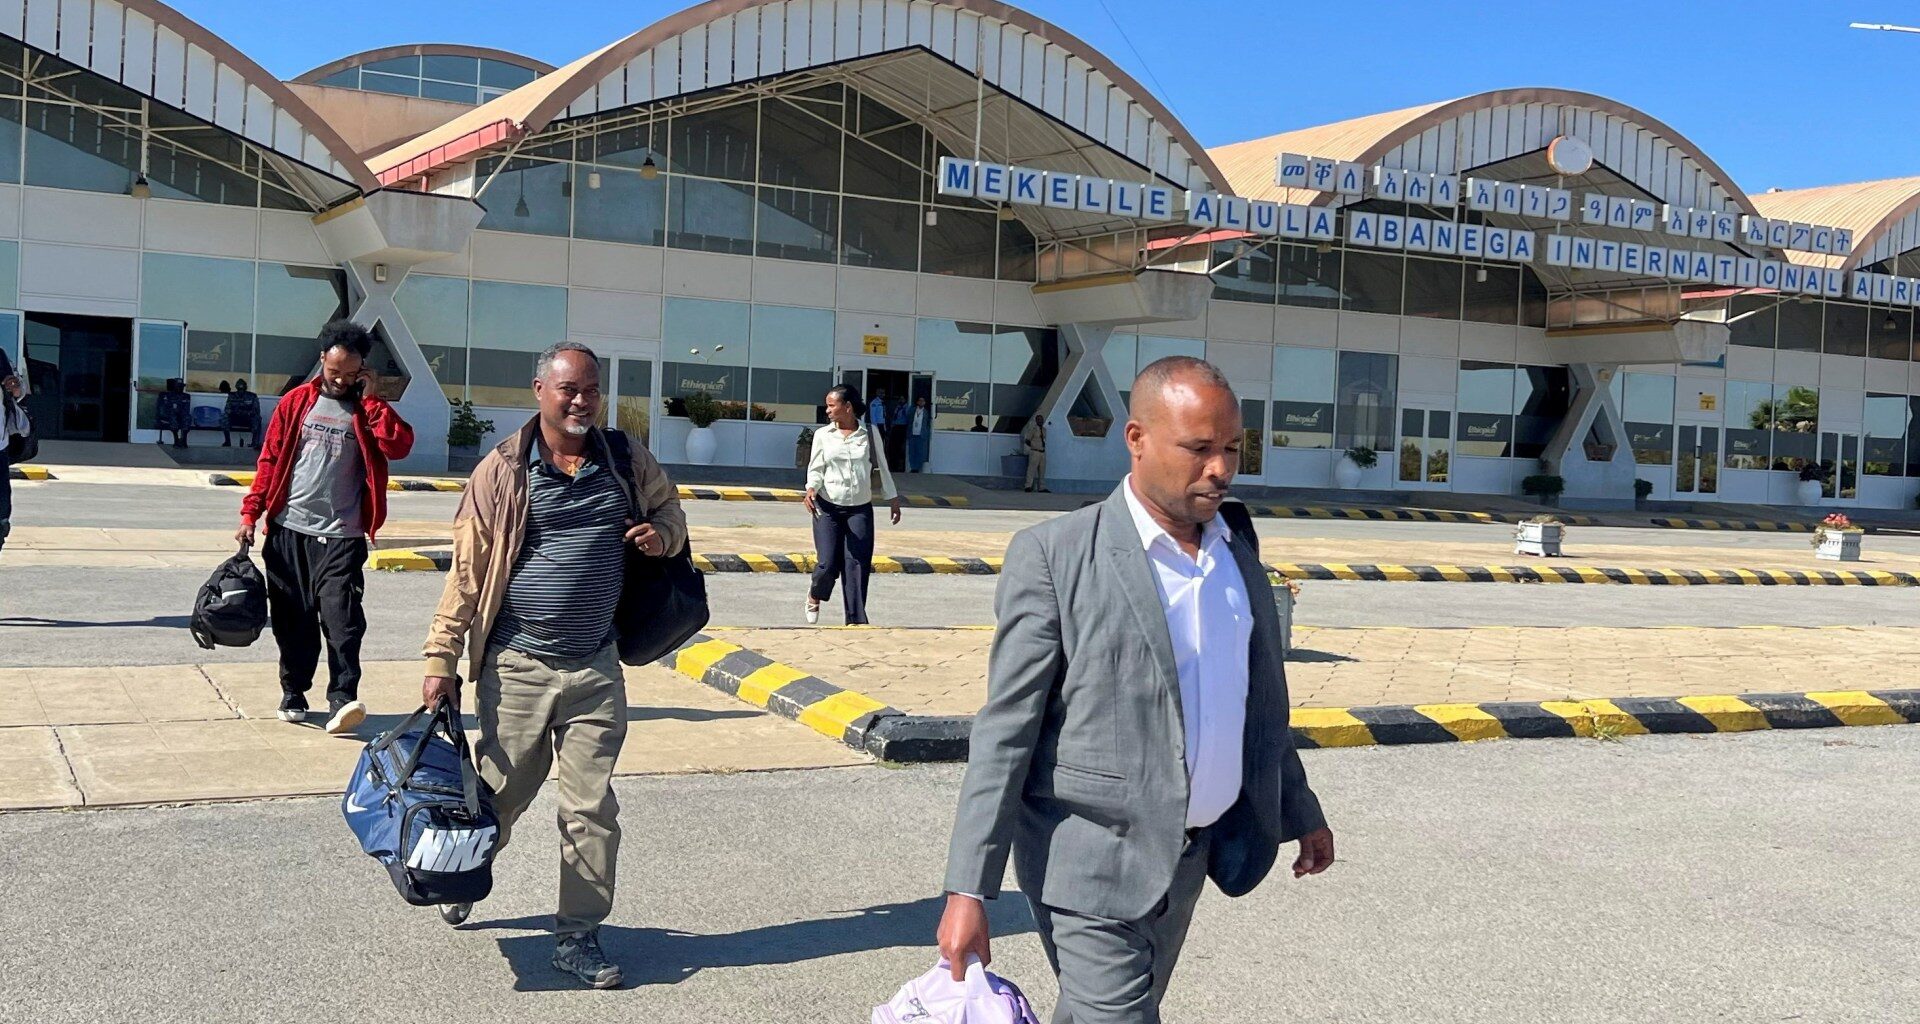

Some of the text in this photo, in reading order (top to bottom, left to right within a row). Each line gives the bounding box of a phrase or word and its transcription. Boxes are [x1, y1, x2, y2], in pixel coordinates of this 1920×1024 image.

[947, 163, 1166, 216] MEKELLE
[1194, 197, 1330, 236] ALULA
[1355, 218, 1530, 258] ABANEGA
[1556, 240, 1837, 292] INTERNATIONAL
[1282, 162, 1356, 190] መቐለ
[1384, 172, 1450, 201] አሉላ
[1590, 200, 1652, 224] ዓለም
[1671, 211, 1732, 236] አቀፍ
[1749, 220, 1850, 252] ኤርፖርት
[681, 378, 725, 391] Ethiopian
[936, 395, 968, 407] thiopian
[406, 824, 497, 873] NIKE
